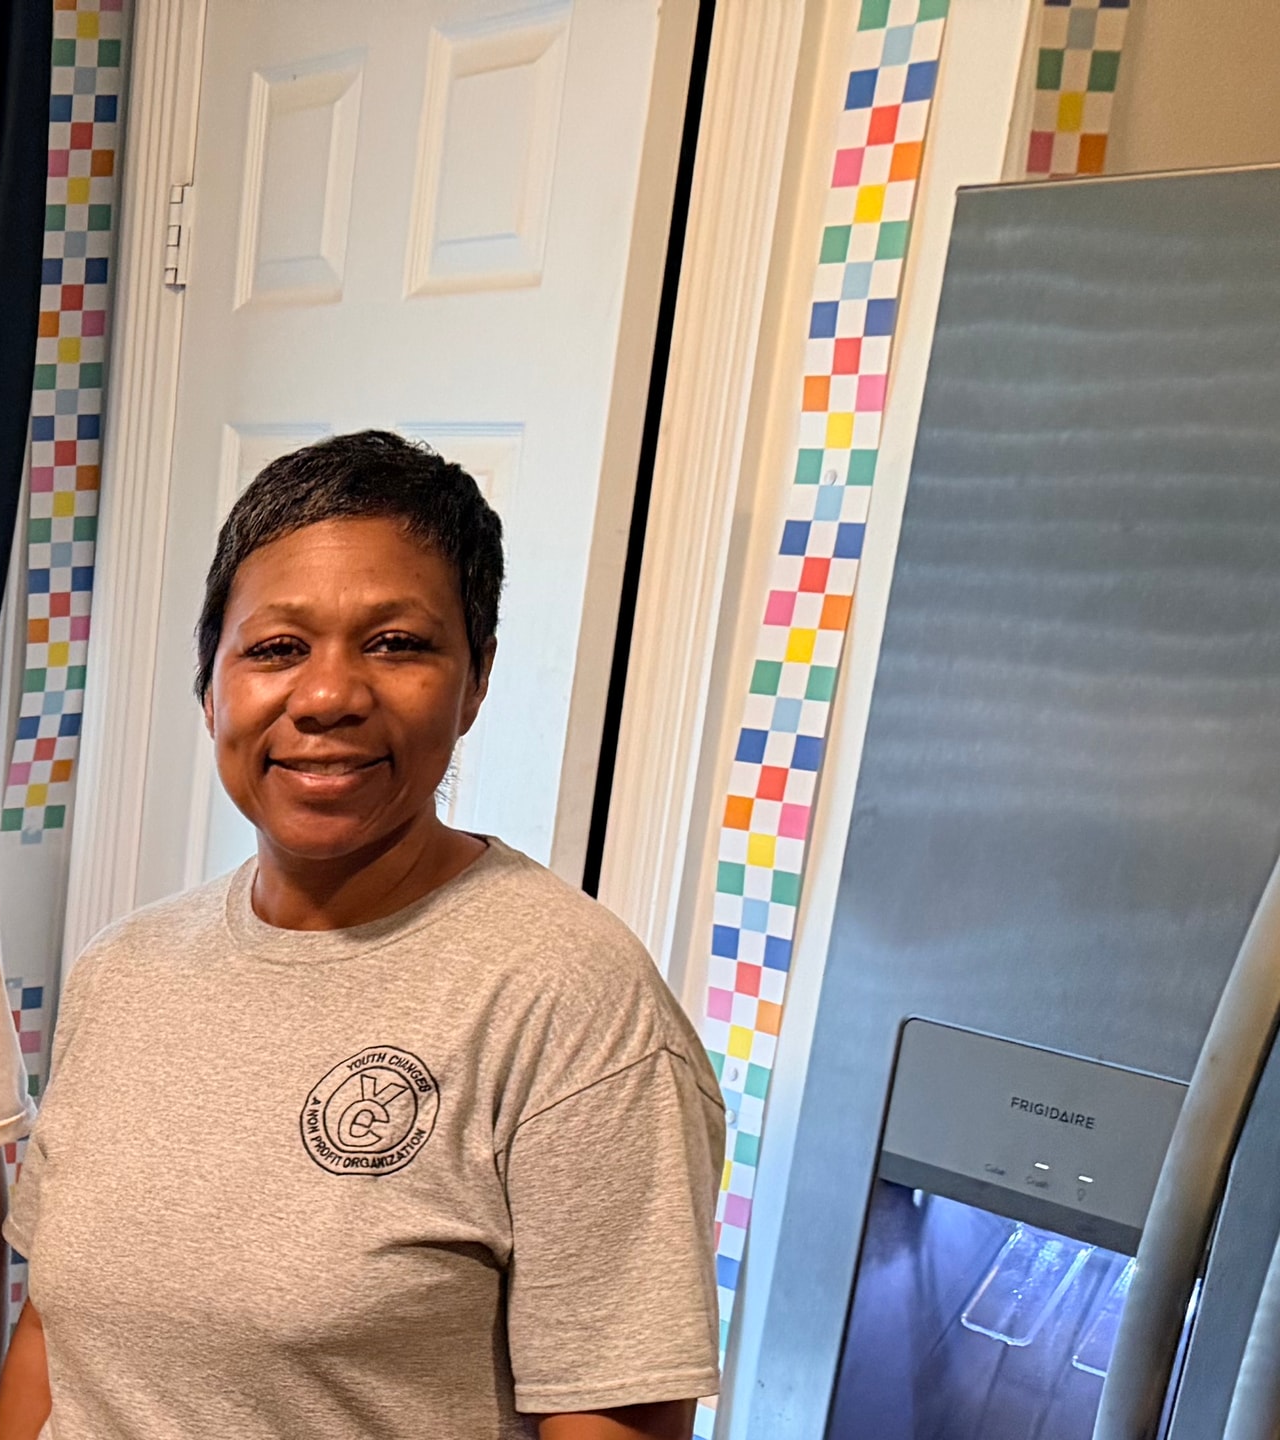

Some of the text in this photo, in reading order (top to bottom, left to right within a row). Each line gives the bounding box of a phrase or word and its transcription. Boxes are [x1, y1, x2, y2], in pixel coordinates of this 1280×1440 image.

[346, 1053, 387, 1071] YOUTH
[1010, 1096, 1096, 1130] FRIGIDAIRE
[306, 1096, 427, 1168] A NON PROFIT ORGANIZATION
